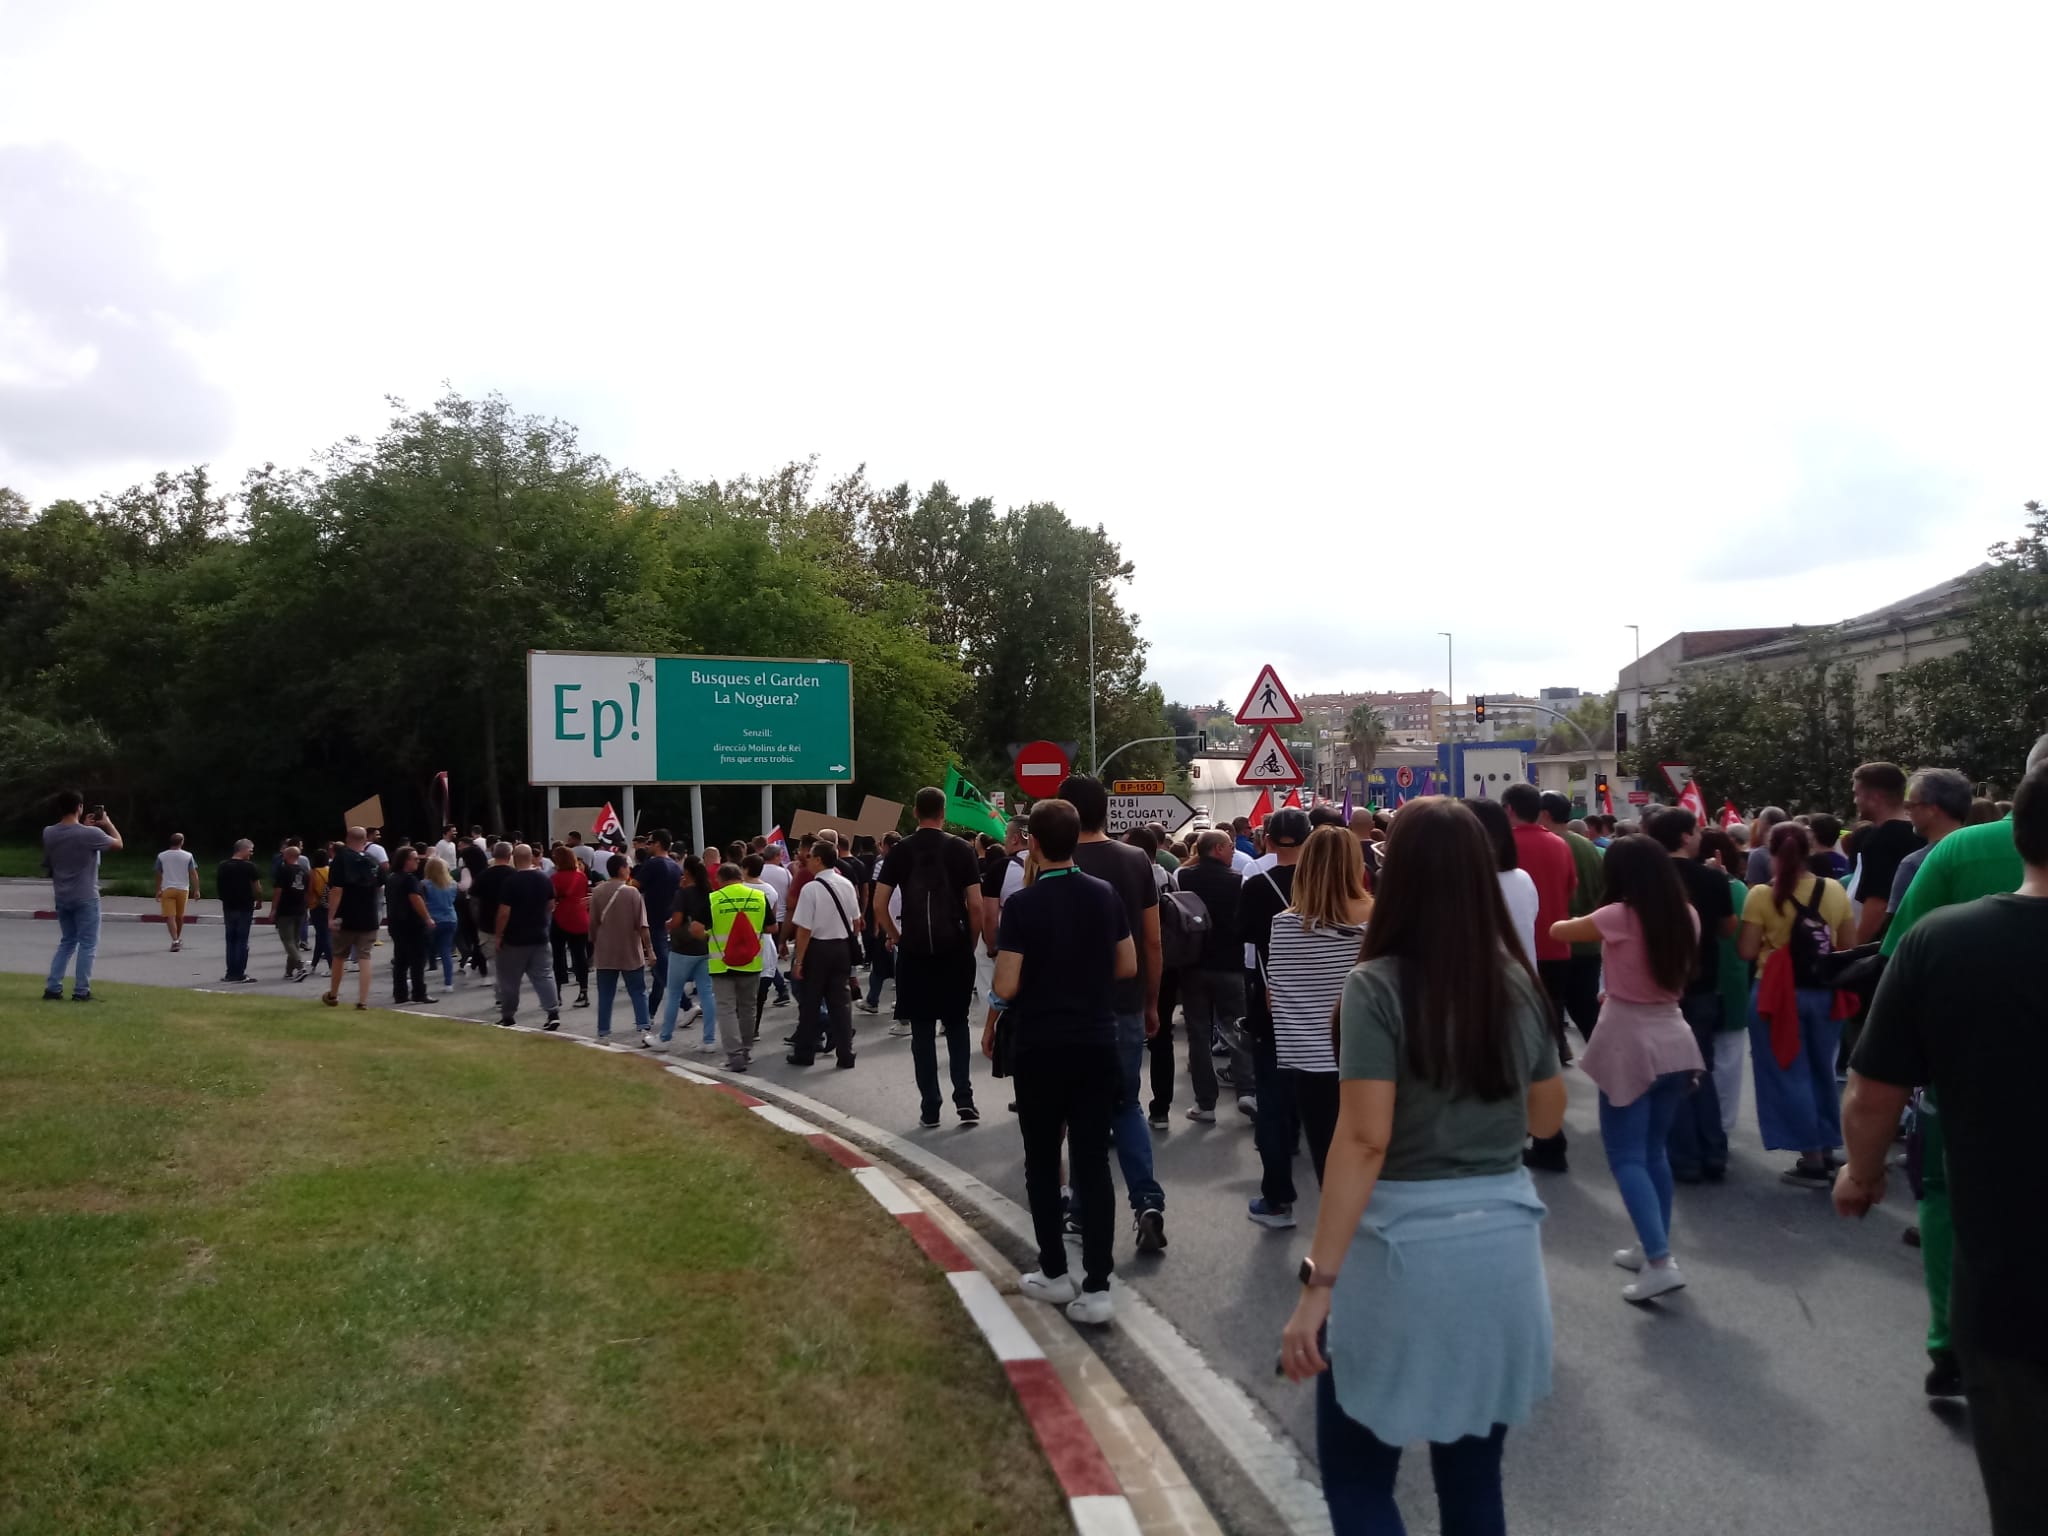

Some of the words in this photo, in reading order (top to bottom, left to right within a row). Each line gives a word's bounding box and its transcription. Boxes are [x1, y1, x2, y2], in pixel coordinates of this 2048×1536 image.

[691, 671, 751, 688] Busques
[754, 672, 766, 686] el
[770, 673, 820, 687] Garden
[714, 691, 731, 704] La
[734, 692, 800, 708] Noguera?
[554, 682, 640, 758] Ep!
[743, 728, 773, 737] Senzill:
[713, 743, 747, 752] direcció
[748, 743, 776, 752] Molins
[777, 744, 788, 752] de
[789, 744, 801, 752] Rei
[720, 754, 736, 764] fins
[737, 756, 752, 765] que
[1120, 784, 1158, 792] BP-1503
[1127, 809, 1164, 819] CUGAT
